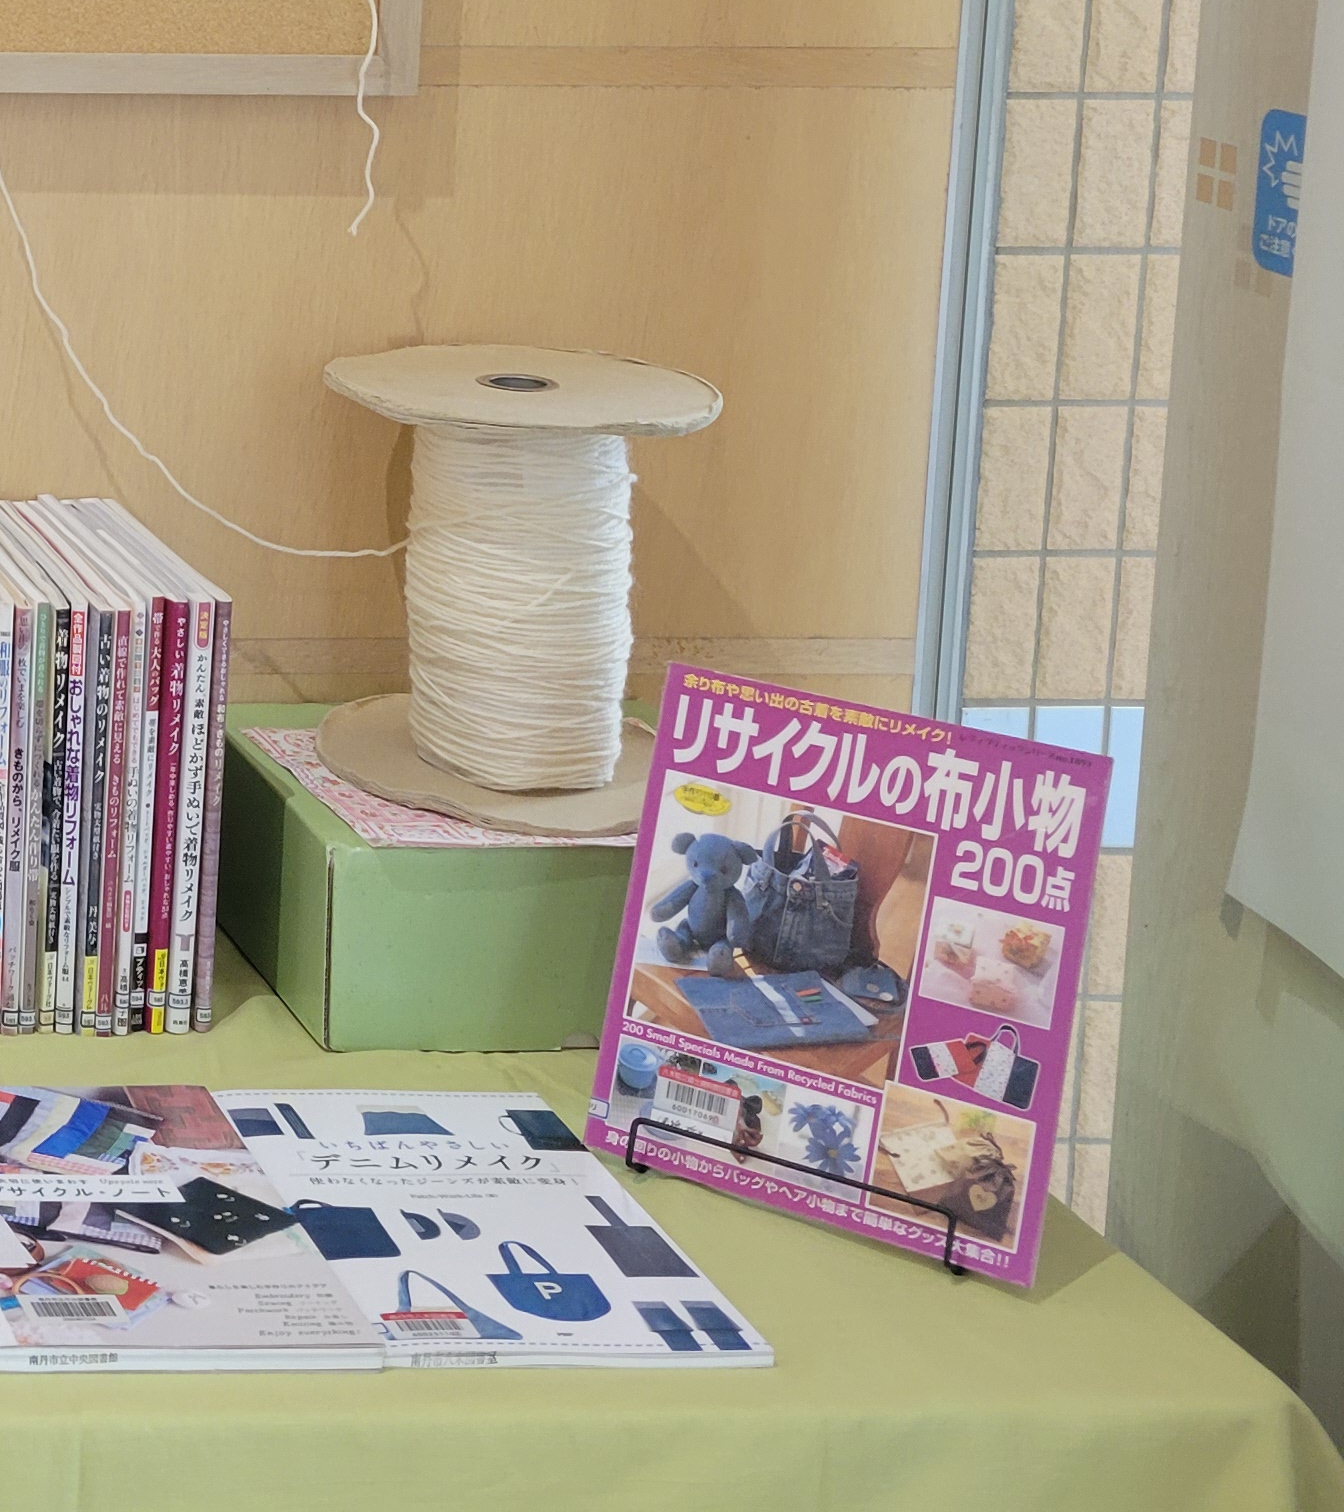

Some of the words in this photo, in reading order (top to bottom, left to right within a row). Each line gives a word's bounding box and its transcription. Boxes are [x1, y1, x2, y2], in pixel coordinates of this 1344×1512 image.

[53, 628, 70, 750] 着物リメイク
[94, 634, 111, 783] 古い着物のリメイク
[168, 617, 188, 756] やさしい着物リメイク
[683, 672, 953, 745] 余り布や思い出の古着を素敵にリメイク！
[672, 692, 1088, 859] リサイクルの布小物
[949, 840, 1076, 914] 200点
[621, 1020, 645, 1037] 200
[645, 1025, 676, 1047] Small
[677, 1035, 722, 1060] Specials
[722, 1048, 755, 1069] Made
[755, 1056, 785, 1078] From
[786, 1065, 837, 1095] Recycled
[837, 1080, 879, 1105] Fabrics
[318, 1138, 510, 1151] いちばんやさしい
[534, 1281, 563, 1300] P
[28, 1351, 120, 1367] 南丹市立中央図書館
